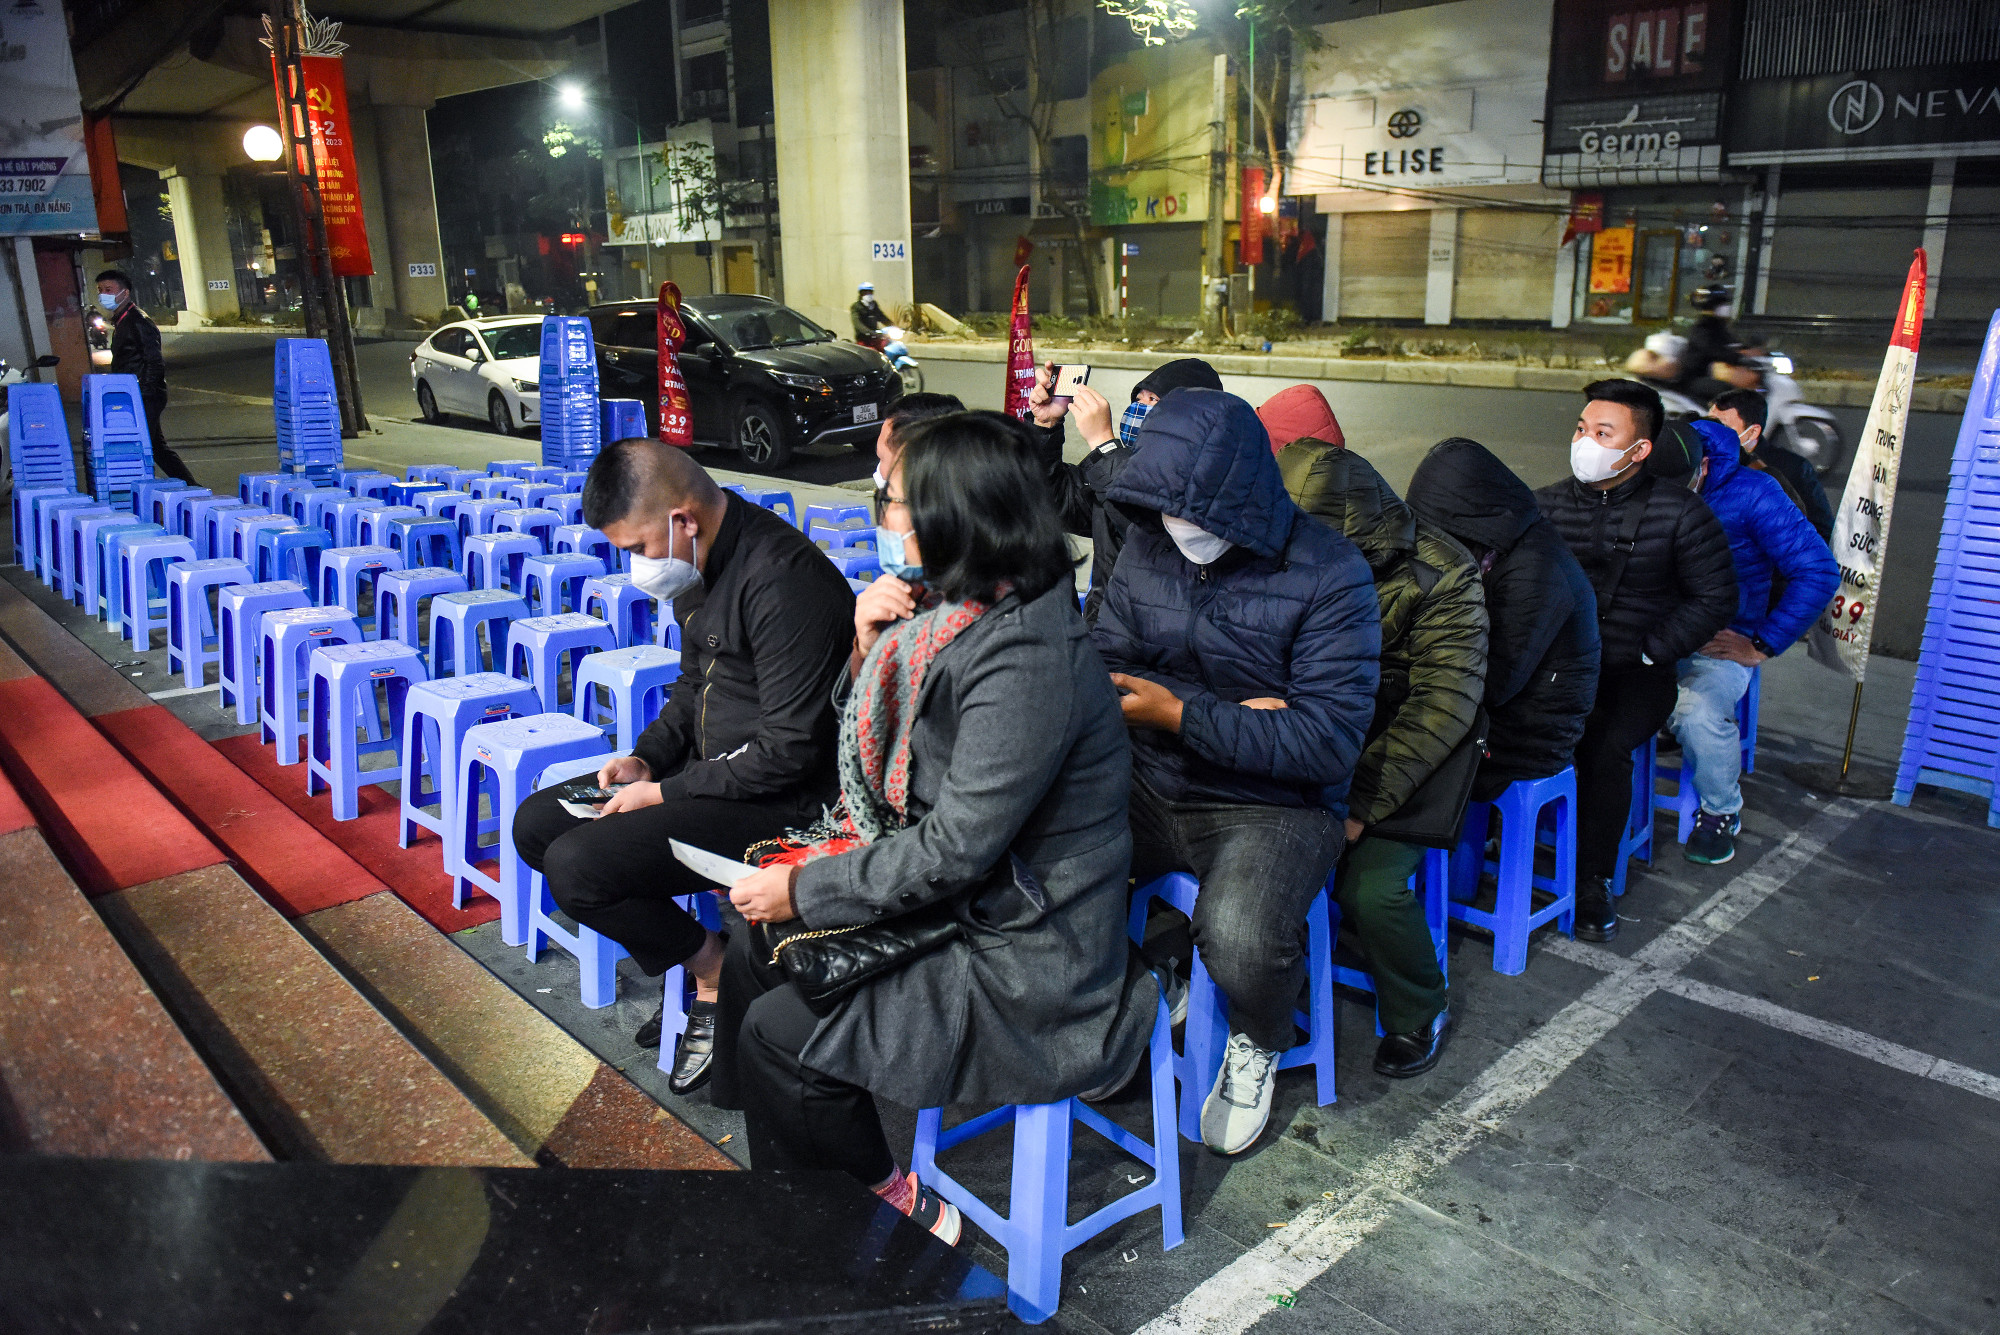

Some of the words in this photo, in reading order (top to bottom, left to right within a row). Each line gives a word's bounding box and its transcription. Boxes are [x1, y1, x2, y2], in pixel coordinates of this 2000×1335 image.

[1607, 14, 1704, 74] SALE
[1580, 131, 1681, 154] Germe
[1365, 147, 1444, 176] ELISE
[874, 243, 905, 258] P334
[410, 265, 435, 275] P333
[209, 281, 229, 290] P332
[664, 379, 686, 391] BTMC
[1014, 367, 1035, 380] TRUNG
[1875, 428, 1897, 451] TRUNG
[1856, 496, 1884, 521] TRANG
[1849, 531, 1875, 554] SỨC
[1837, 563, 1866, 588] TMC
[1832, 627, 1858, 644] GIẤY
